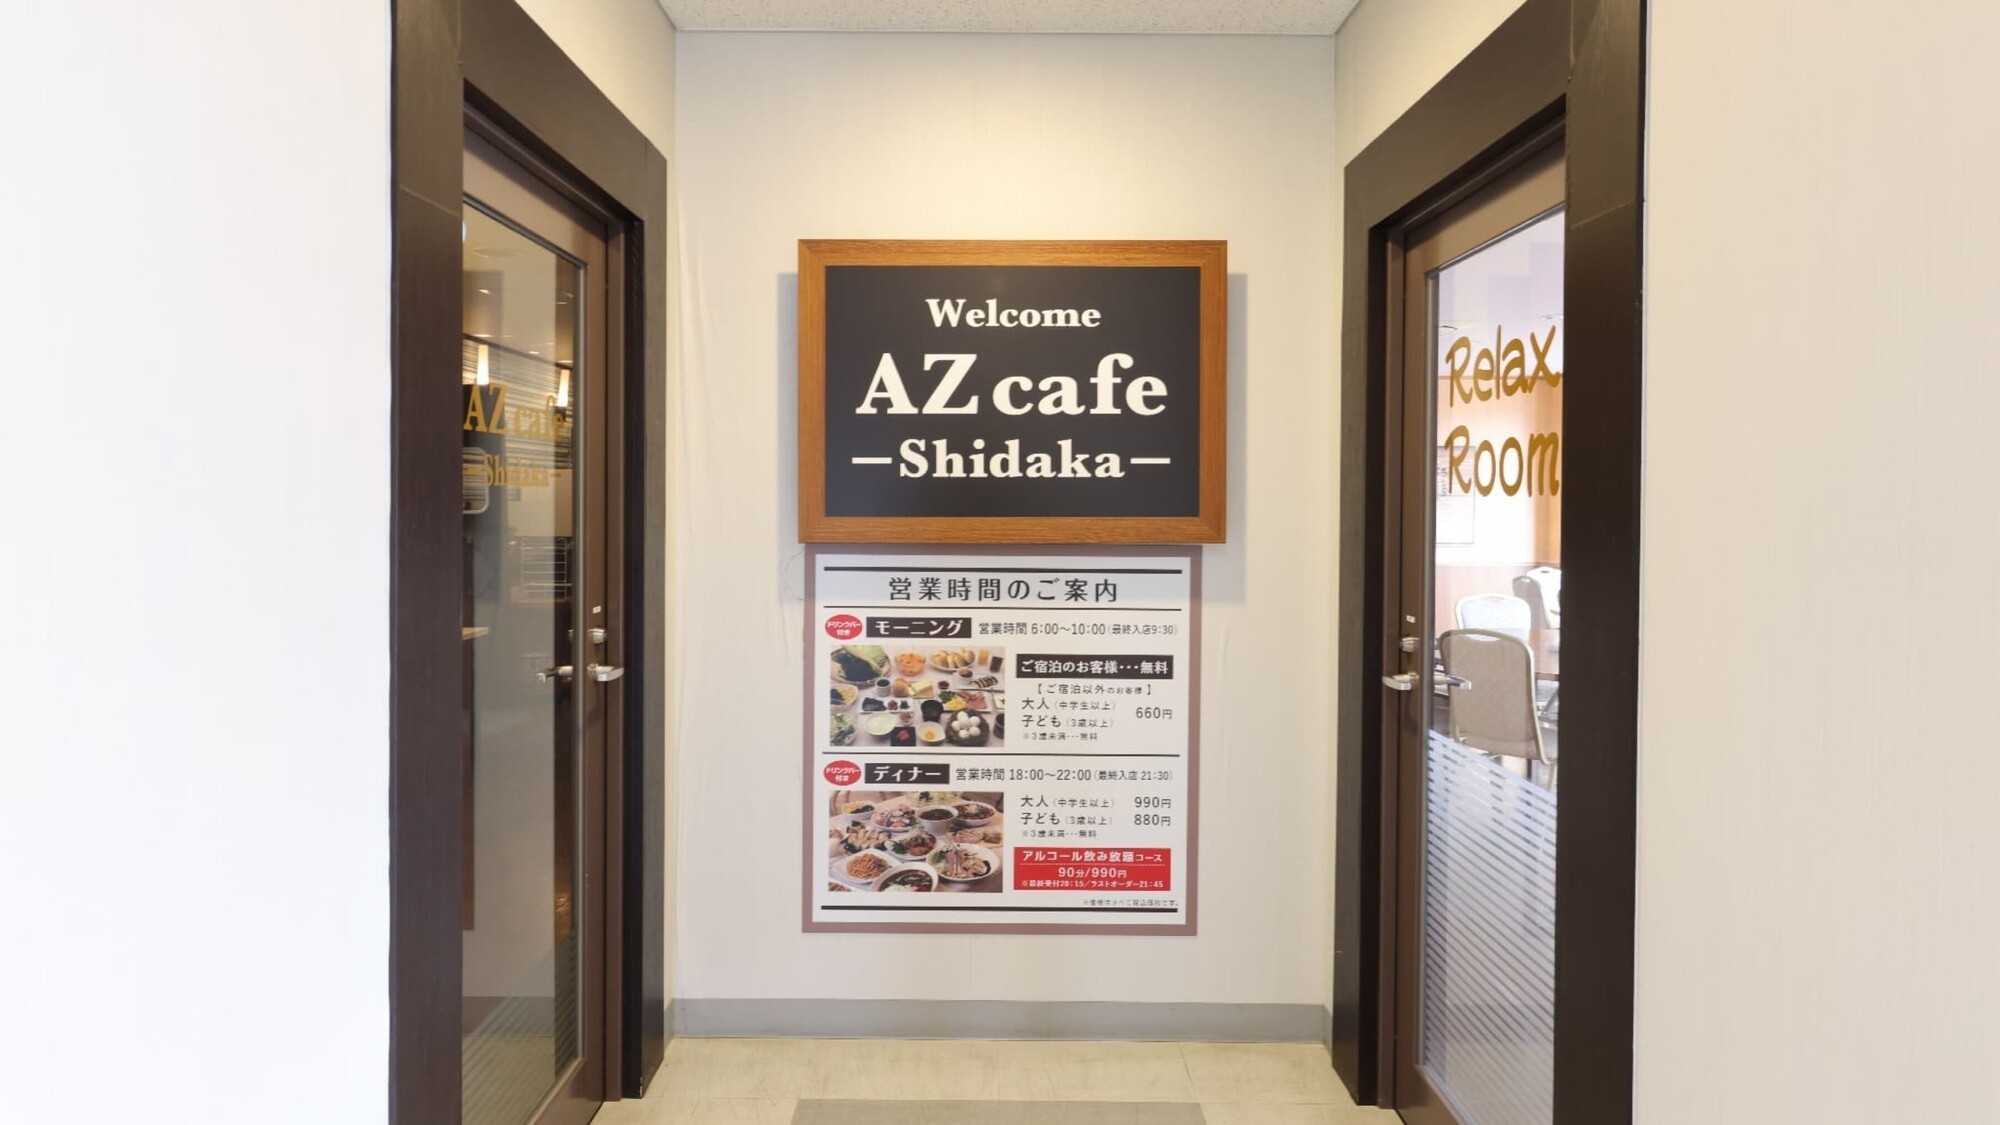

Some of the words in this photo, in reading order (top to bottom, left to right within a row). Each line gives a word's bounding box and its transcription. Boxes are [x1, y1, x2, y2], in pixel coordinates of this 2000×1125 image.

[926, 298, 1101, 328] Welcome
[1445, 325, 1561, 408] Relax
[856, 352, 979, 415] AZ
[992, 353, 1168, 416] cafe
[463, 383, 508, 434] AZ
[1444, 425, 1559, 498] Room
[889, 577, 1118, 602] 営業時間のご案内
[875, 619, 963, 636] モーニング
[1135, 706, 1173, 720] 660円
[874, 765, 942, 782] ディナー
[1134, 796, 1172, 809] 990円
[1134, 814, 1171, 826] 880円
